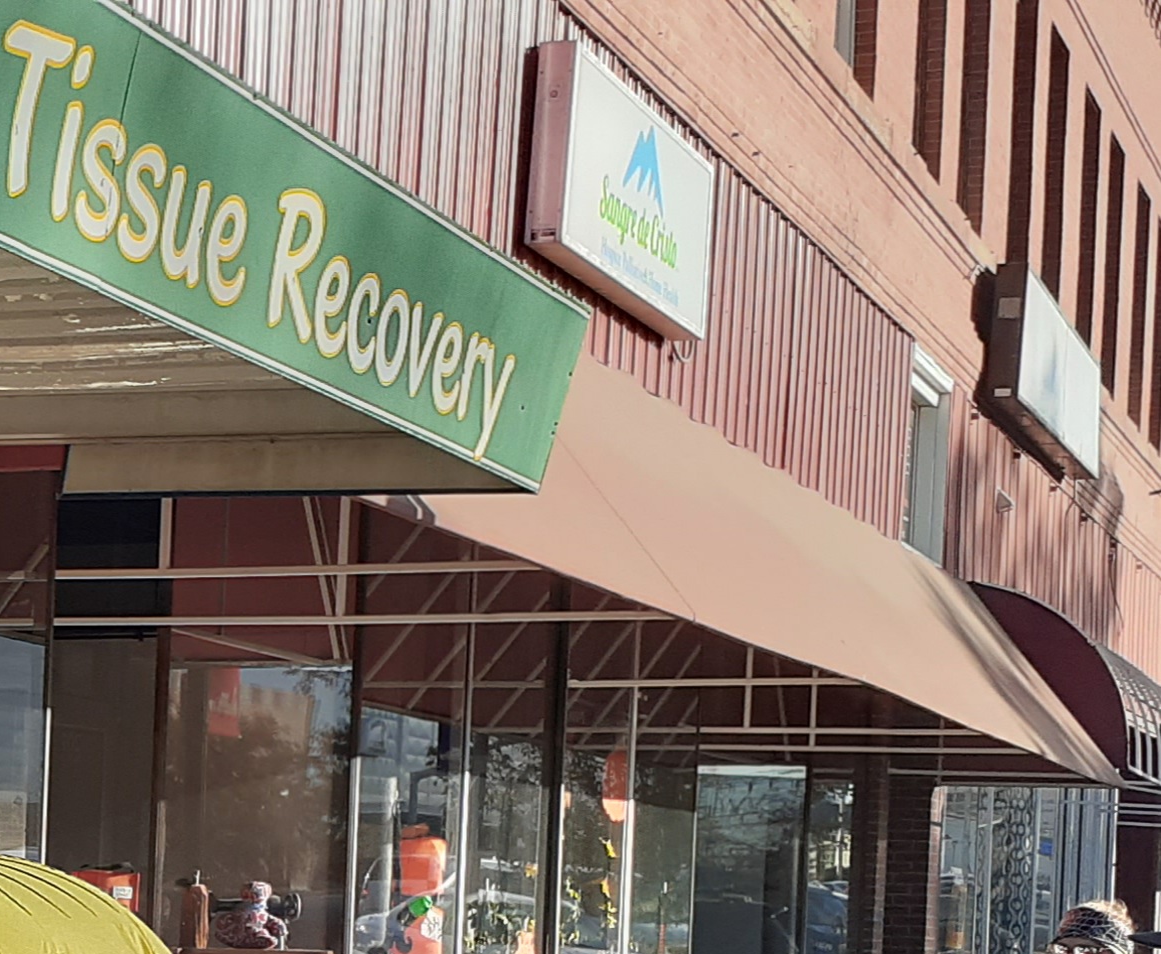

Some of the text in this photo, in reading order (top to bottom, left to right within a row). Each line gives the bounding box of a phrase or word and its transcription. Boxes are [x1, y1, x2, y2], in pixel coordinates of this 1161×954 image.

[5, 20, 247, 306] Tissue
[268, 187, 515, 459] Recovery
[599, 174, 637, 245] Sangre
